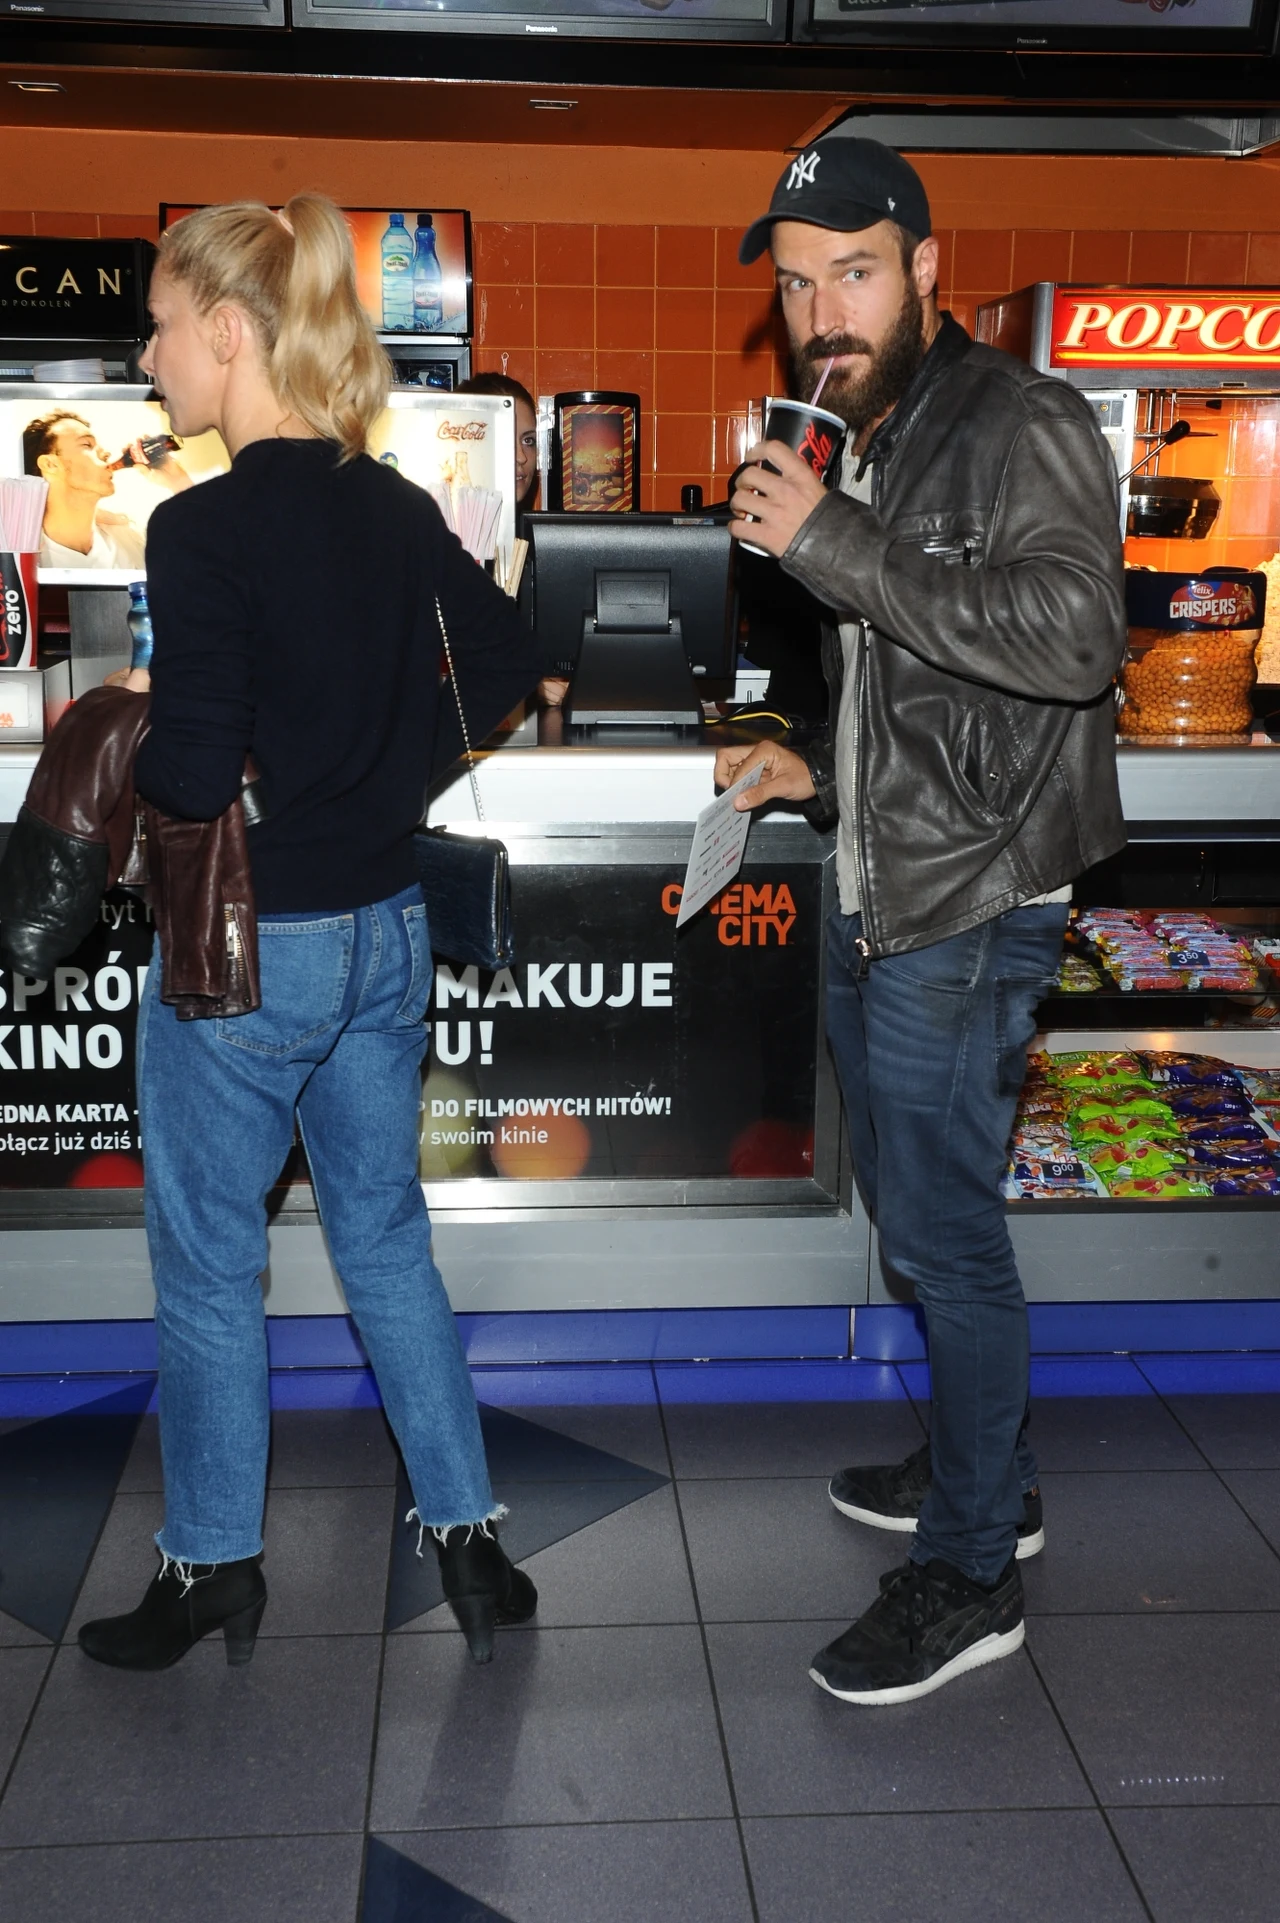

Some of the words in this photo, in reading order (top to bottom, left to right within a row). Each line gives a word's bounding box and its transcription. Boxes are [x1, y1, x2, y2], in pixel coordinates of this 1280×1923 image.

[786, 151, 821, 191] NY
[5, 589, 22, 636] zero
[1169, 598, 1236, 619] CRISPERS
[661, 883, 797, 915] CEMA
[717, 915, 797, 946] CITY
[55, 1103, 129, 1122] KARTA
[431, 1099, 459, 1117] DO
[465, 1097, 590, 1117] FILMOWYCH
[596, 1092, 672, 1116] HITÓW!
[53, 1131, 85, 1155] już
[90, 1130, 132, 1150] dziś
[431, 1126, 495, 1145] swoim
[501, 1125, 549, 1144] kinie
